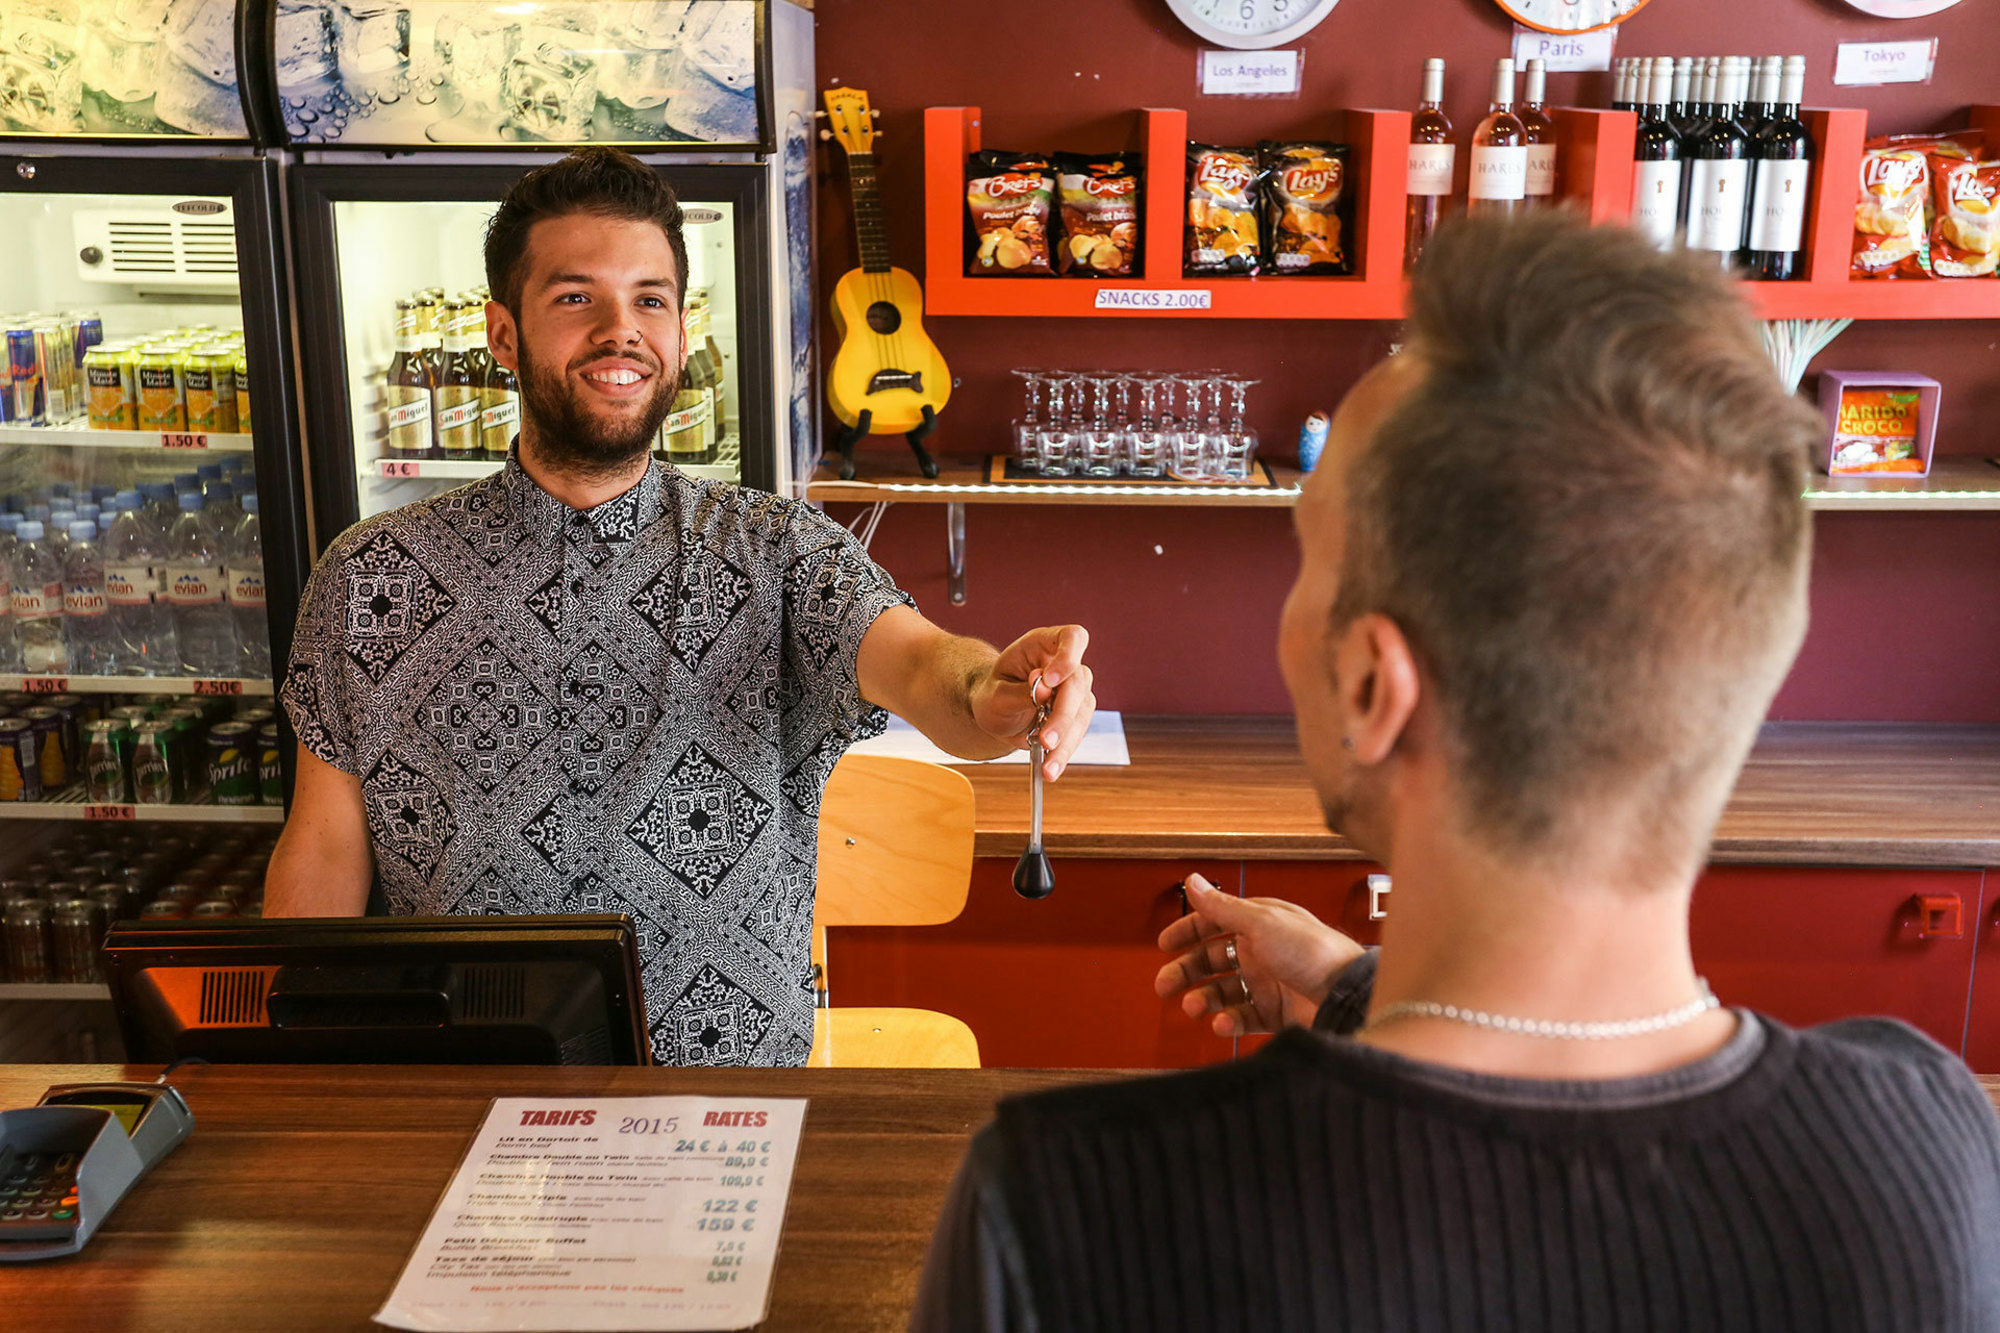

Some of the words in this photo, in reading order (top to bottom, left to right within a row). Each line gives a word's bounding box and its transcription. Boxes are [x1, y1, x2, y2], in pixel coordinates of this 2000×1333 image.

[1241, 0, 1254, 20] 6
[1539, 39, 1585, 57] Paris
[1863, 49, 1907, 64] Tokyo
[1213, 65, 1234, 77] Los
[1238, 64, 1287, 79] Angeles
[983, 211, 1014, 220] Poulet
[1086, 211, 1113, 222] Poulet
[1098, 290, 1160, 306] SNACKS
[1165, 293, 1209, 308] 2.00€
[397, 403, 428, 422] Miguel
[486, 405, 516, 423] Miguel
[439, 413, 454, 428] San
[664, 416, 681, 432] San
[1841, 419, 1903, 435] CROCO
[163, 435, 193, 448] 1.50
[196, 436, 206, 448] €
[386, 463, 396, 475] 4
[401, 463, 411, 475] €
[106, 583, 134, 595] evian
[174, 582, 208, 595] evian
[65, 595, 103, 608] evian
[24, 680, 55, 692] 1.50
[56, 681, 67, 692] €
[195, 681, 241, 694] 2.50€
[89, 806, 118, 818] 1.50
[120, 807, 130, 818] €
[519, 1109, 598, 1127] TARIFS
[702, 1110, 769, 1128] RATES
[618, 1116, 681, 1135] 2015
[674, 1139, 696, 1153] 24
[699, 1139, 711, 1153] €
[717, 1140, 728, 1153] à
[736, 1140, 757, 1154] 40
[760, 1140, 772, 1154] €
[759, 1156, 770, 1168] €
[755, 1176, 765, 1187] €
[702, 1199, 739, 1213] 122
[744, 1199, 758, 1213] €
[697, 1218, 735, 1232] 159
[741, 1218, 756, 1232] €
[735, 1255, 744, 1267] €
